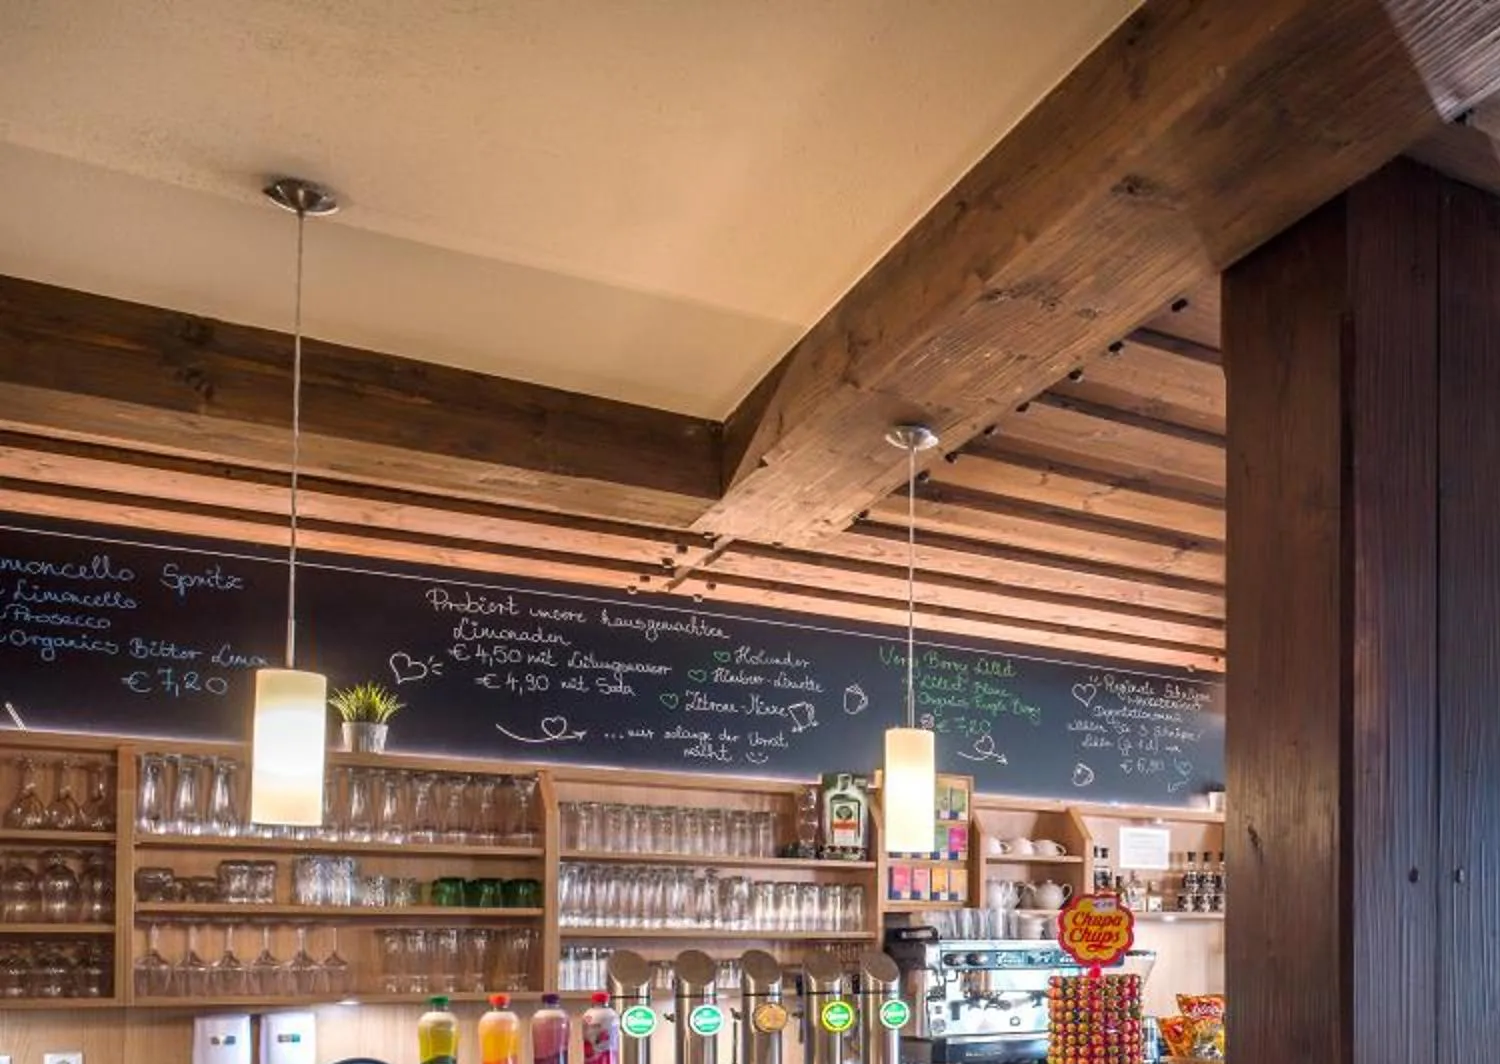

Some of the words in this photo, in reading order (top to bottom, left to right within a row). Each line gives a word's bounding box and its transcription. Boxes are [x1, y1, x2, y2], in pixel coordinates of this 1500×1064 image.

[160, 562, 245, 597] Spritz
[13, 578, 138, 609] Limoncello
[425, 587, 520, 617] Probiert
[453, 616, 572, 647] Limonaden
[733, 645, 811, 668] Holunder
[597, 676, 637, 697] Soda
[1072, 911, 1123, 929] Chupa
[1069, 927, 1121, 944] Chups
